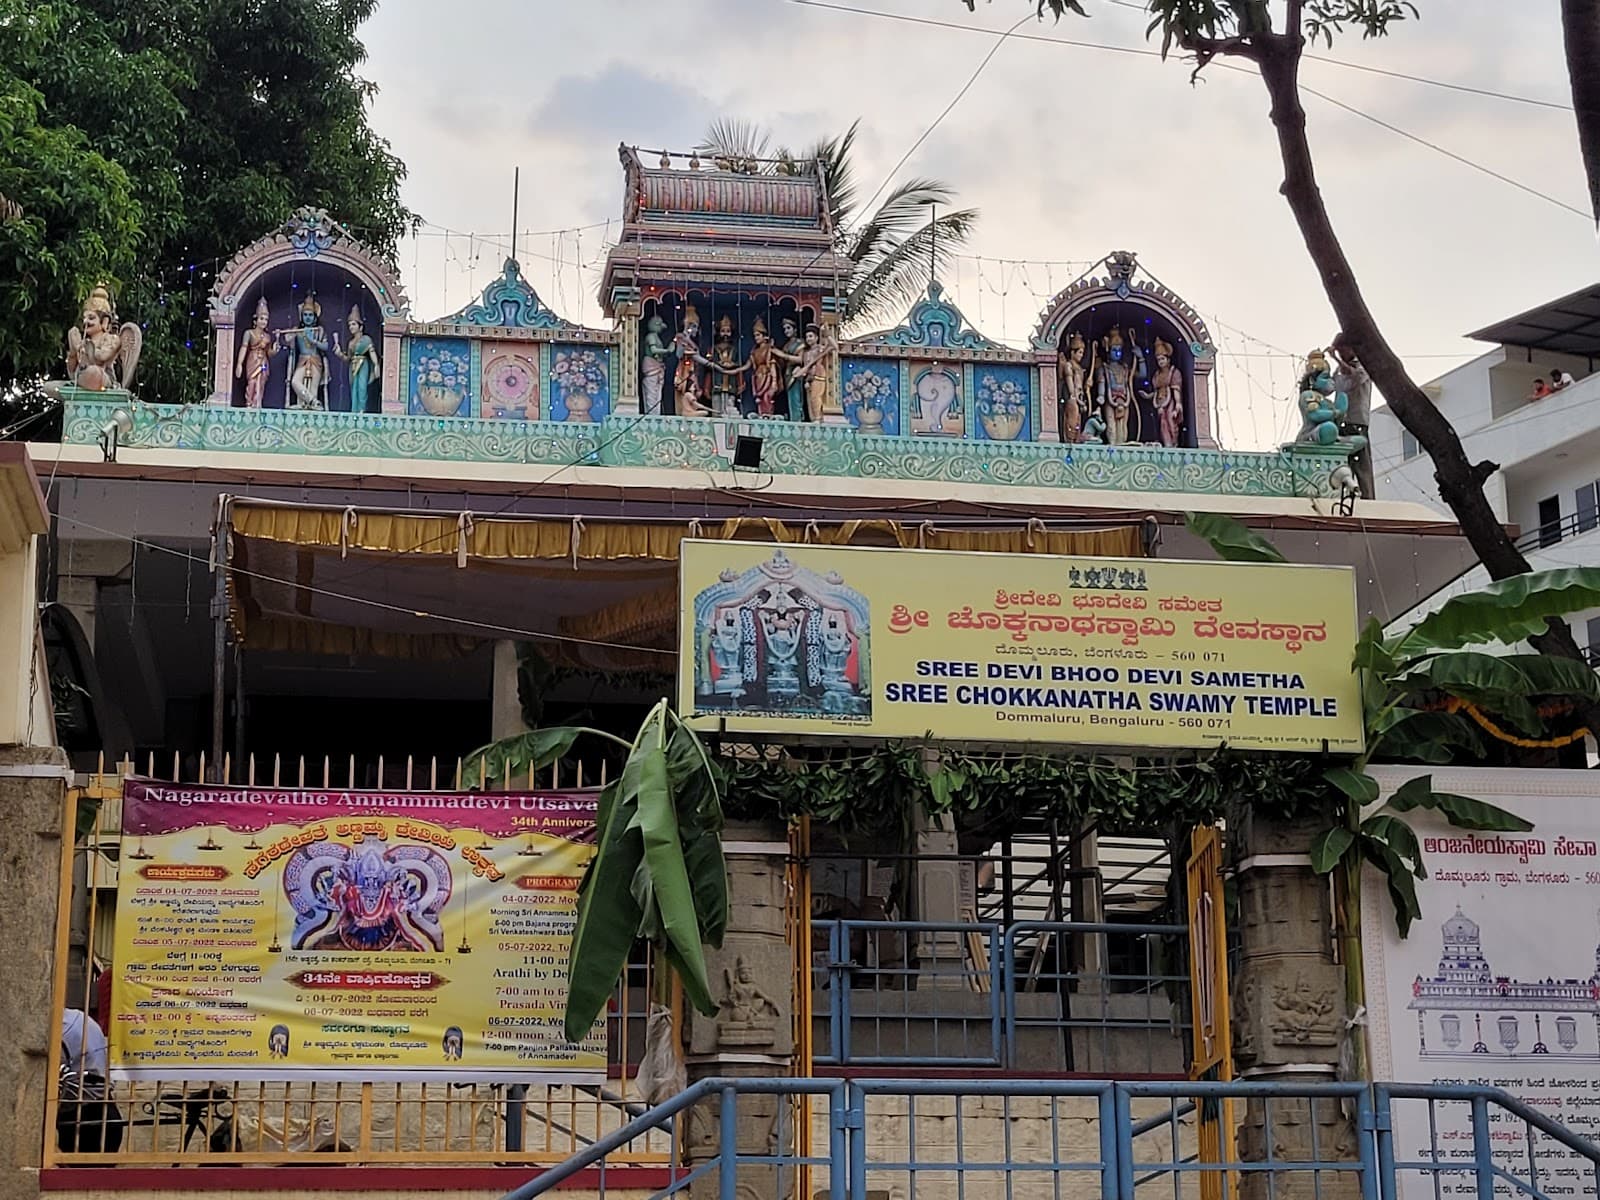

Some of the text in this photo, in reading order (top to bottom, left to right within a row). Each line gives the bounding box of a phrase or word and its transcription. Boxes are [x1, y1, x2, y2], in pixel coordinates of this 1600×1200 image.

[994, 589, 1223, 613] ಶ್ರೀದೇವಿ ಭೂದೇವಿ ಸಮೇತ
[888, 604, 1327, 654] ಶ್ರೀ ಚೊಕ್ಕನಾಥಸ್ವಾಮಿ ದೇವಸ್ಥಾನ
[1084, 645, 1148, 660] ಬೆಂಗಳೂರು
[1171, 650, 1196, 662] 560
[1203, 651, 1225, 663] 071
[916, 660, 1305, 689] SREE DEVI BHOO DEVI SAMETHA
[885, 683, 1337, 717] SREE CHOKKANATHA SWAMY TEMPLE
[996, 711, 1085, 725] Dommaluru,
[1090, 714, 1164, 728] Bengaluru
[1178, 717, 1203, 728] 560
[1207, 718, 1231, 729] 071
[144, 788, 328, 806] Nagaradevathe
[335, 792, 511, 810] Annammadevi
[511, 816, 538, 827] 34th
[244, 820, 505, 882] ನಗರದೇವತೆ ಅಣ್ಣಮ್ಮ ದೇವಿಯ ಉತ್ಸವ
[1424, 834, 1597, 864] ಆಂಜನೇಯಸ್ವಾಮಿ ಸೇವಾ
[1435, 868, 1490, 888] ದೊಮ್ಮಲೂರು
[1526, 872, 1570, 885] ಬೆಂಗಳೂರು
[165, 888, 218, 896] 04-07-2022
[502, 895, 555, 904] 04-07-2022
[491, 908, 519, 917] Morning
[522, 908, 532, 916] Sri
[534, 909, 569, 917] Annamma
[495, 919, 550, 929] 6-00 pm Bajana
[500, 928, 555, 936] Venkateshwara
[162, 938, 214, 947] 05-07-2022
[523, 956, 554, 965] 11-00
[303, 972, 341, 984] 34ನೇ
[493, 968, 530, 978] Arathi
[534, 968, 548, 980] by
[495, 986, 519, 996] 7-00
[523, 988, 540, 996] am
[544, 986, 554, 996] to
[312, 994, 372, 1003] 04-07-2022
[500, 999, 544, 1009] Prasada
[304, 1008, 363, 1017] 06-07-2022
[481, 1030, 544, 1040] 12-00 noon
[485, 1043, 502, 1051] 7-00
[504, 1044, 516, 1052] pm
